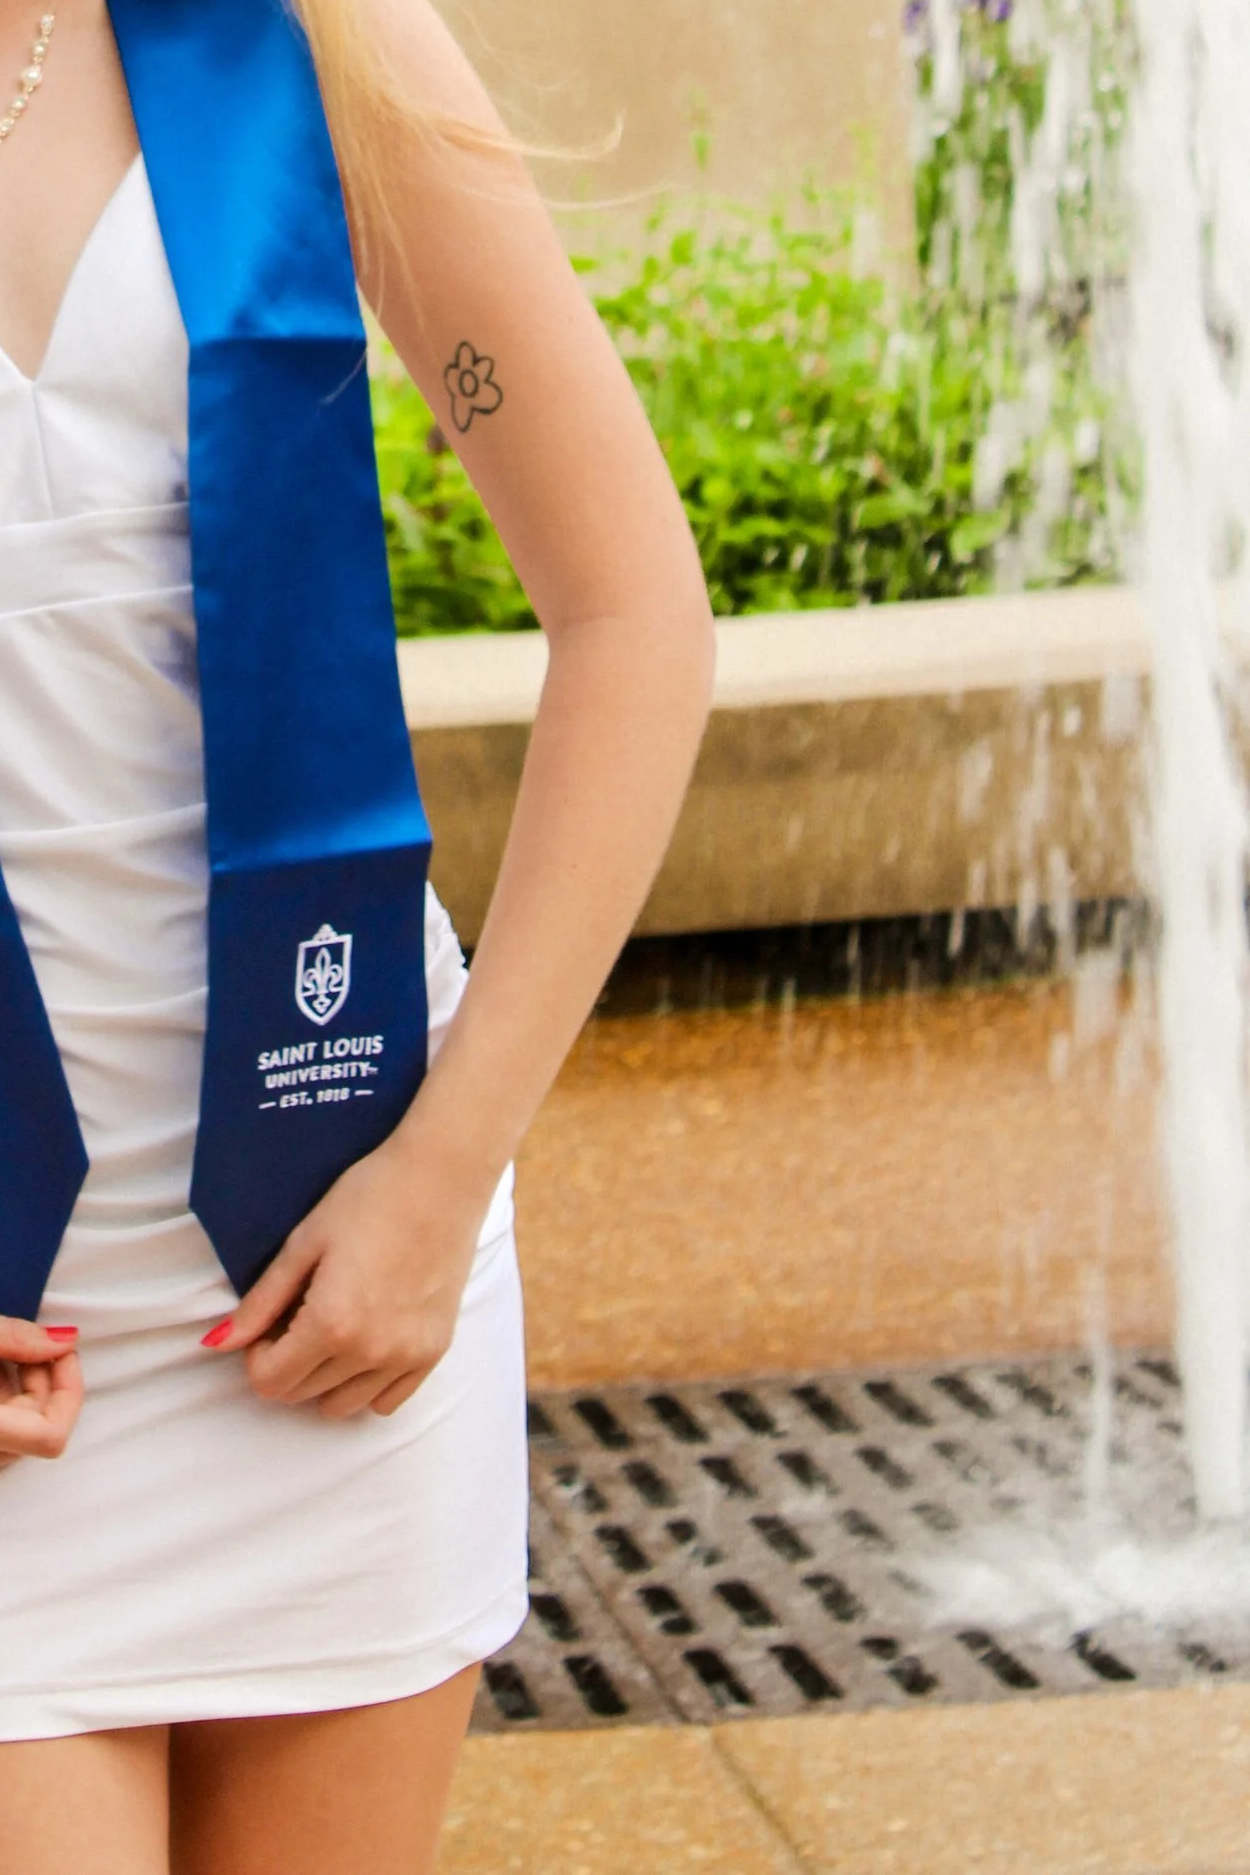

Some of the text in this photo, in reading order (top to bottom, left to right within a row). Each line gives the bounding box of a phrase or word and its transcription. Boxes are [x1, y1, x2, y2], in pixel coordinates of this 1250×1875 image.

[257, 1034, 384, 1071] SAINT LOUIS
[279, 1087, 350, 1109] EST. 1818
